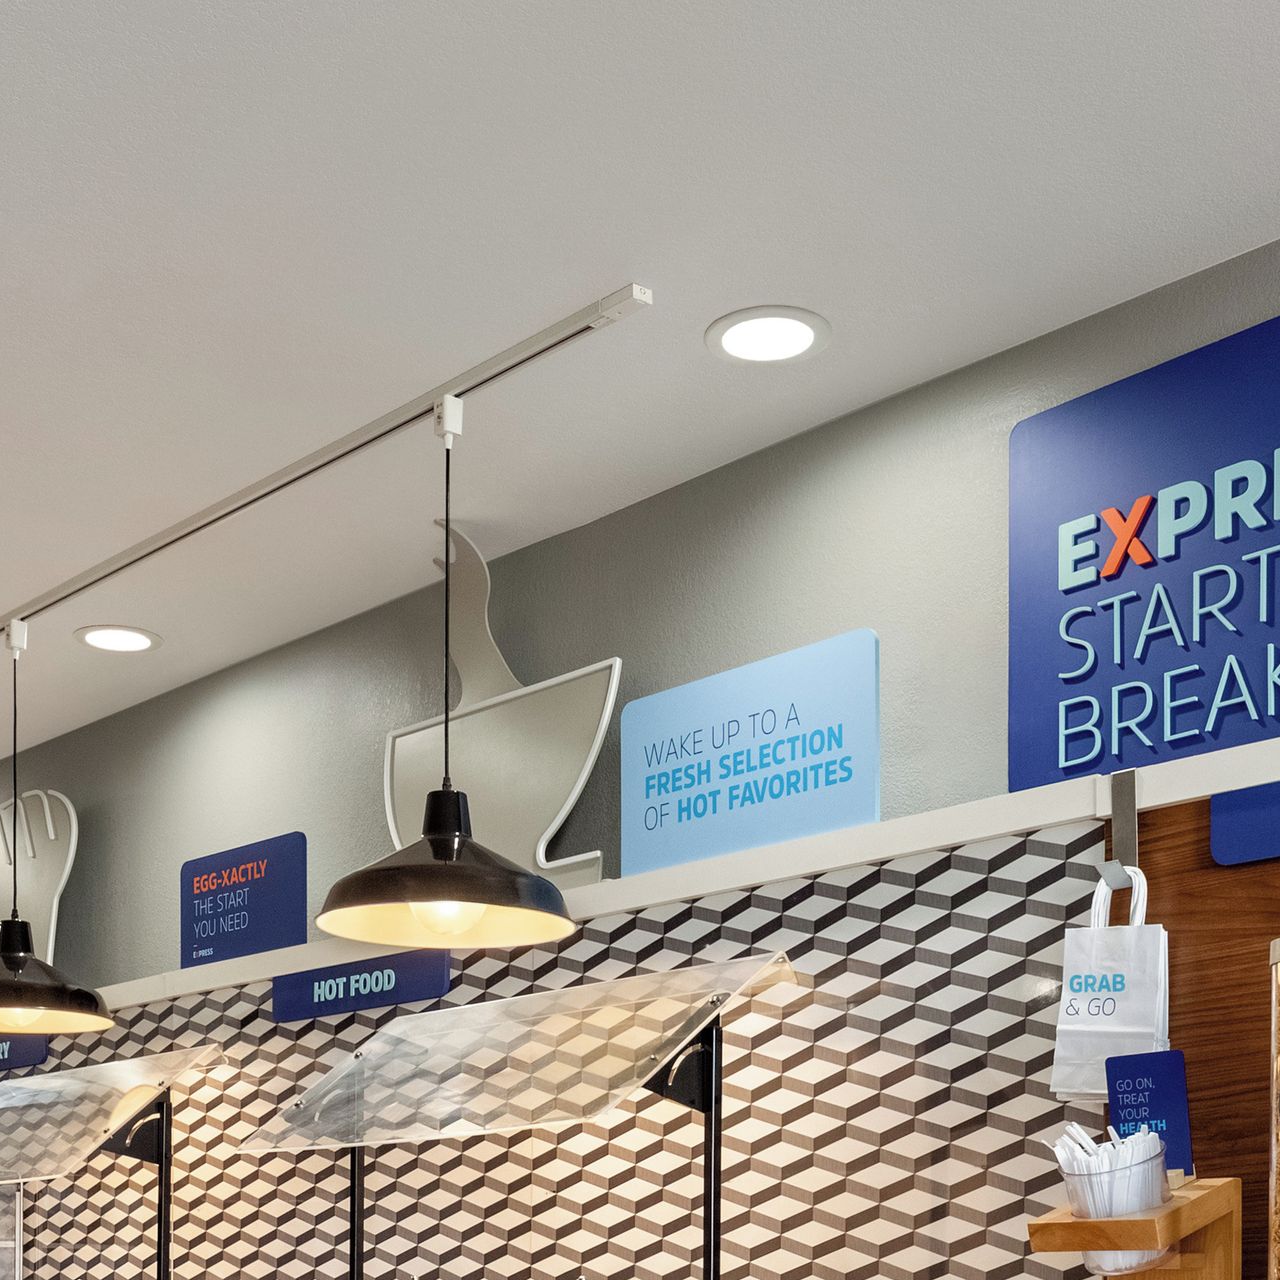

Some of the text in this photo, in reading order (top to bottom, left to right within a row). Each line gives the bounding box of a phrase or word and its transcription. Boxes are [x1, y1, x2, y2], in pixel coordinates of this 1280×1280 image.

[644, 703, 800, 768] WAKE UP TO A
[645, 723, 843, 799] FRESH SELECTION
[644, 755, 853, 830] OF HOT FAVORITES
[193, 859, 267, 894] EGG-XACTLY
[193, 887, 250, 917] THE START
[193, 911, 249, 939] YOU NEED
[313, 968, 396, 1003] HOT FOOD
[1069, 974, 1126, 993] GRAB
[1065, 997, 1117, 1016] & GO
[1116, 1077, 1155, 1091] GO ON.
[1118, 1092, 1150, 1105] TREAT
[1119, 1107, 1150, 1120] YOUR
